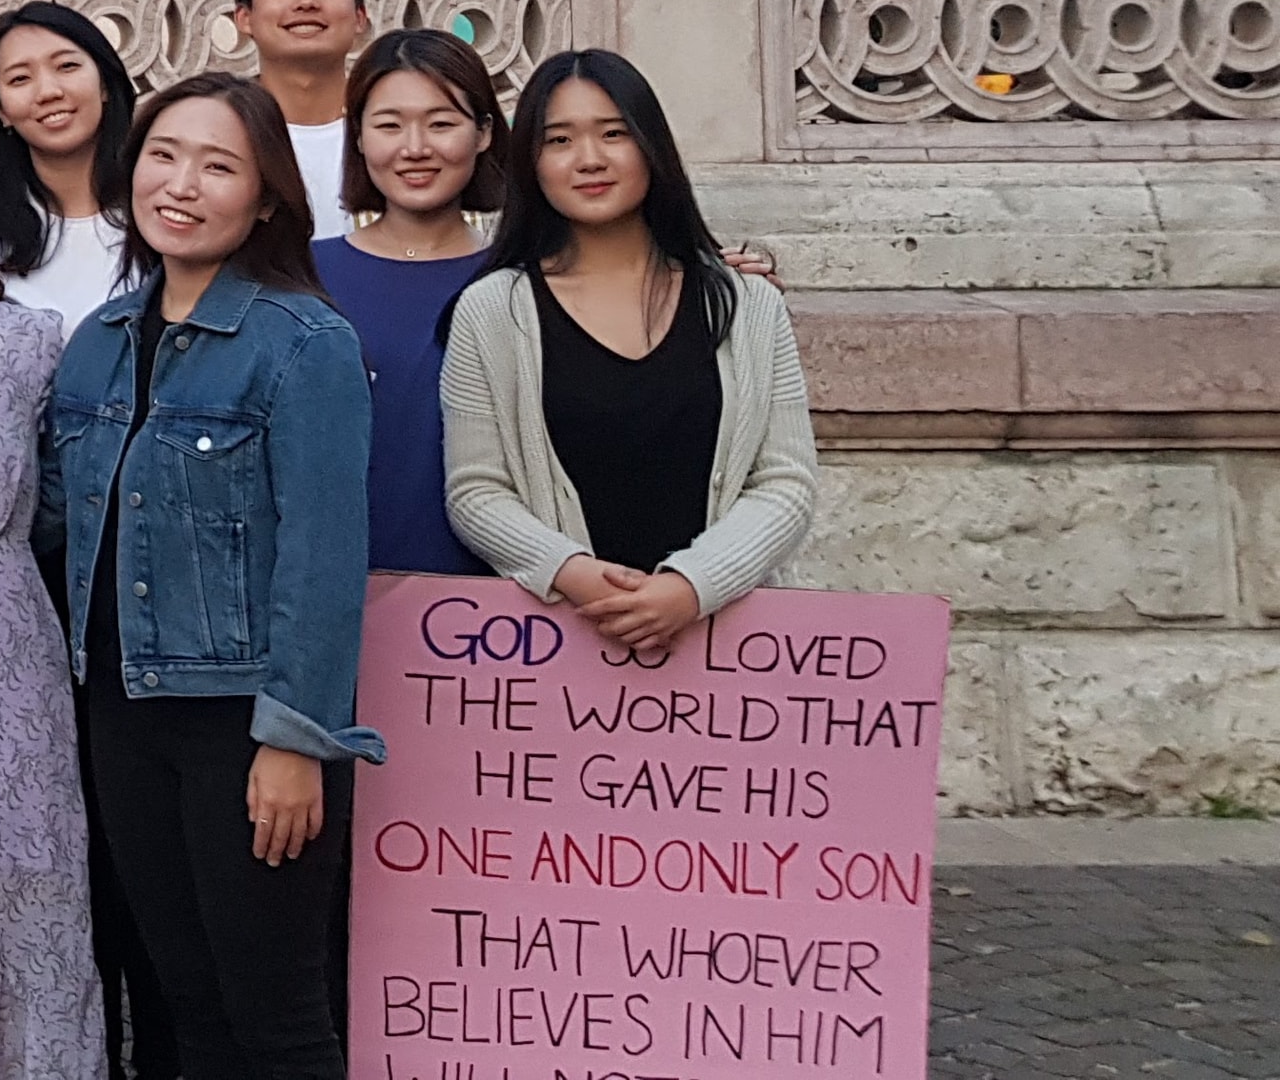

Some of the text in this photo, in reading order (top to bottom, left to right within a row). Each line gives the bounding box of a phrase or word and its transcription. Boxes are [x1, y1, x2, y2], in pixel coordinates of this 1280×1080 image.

[421, 596, 887, 680] GOD LOVED
[404, 672, 938, 748] THE WORLD THAT
[475, 750, 830, 820] HE GAVE HIS
[374, 820, 921, 905] ONE AND ONLY SON
[431, 907, 883, 996] THAT WHOEVER
[383, 975, 885, 1074] BELIEVES IN HIM
